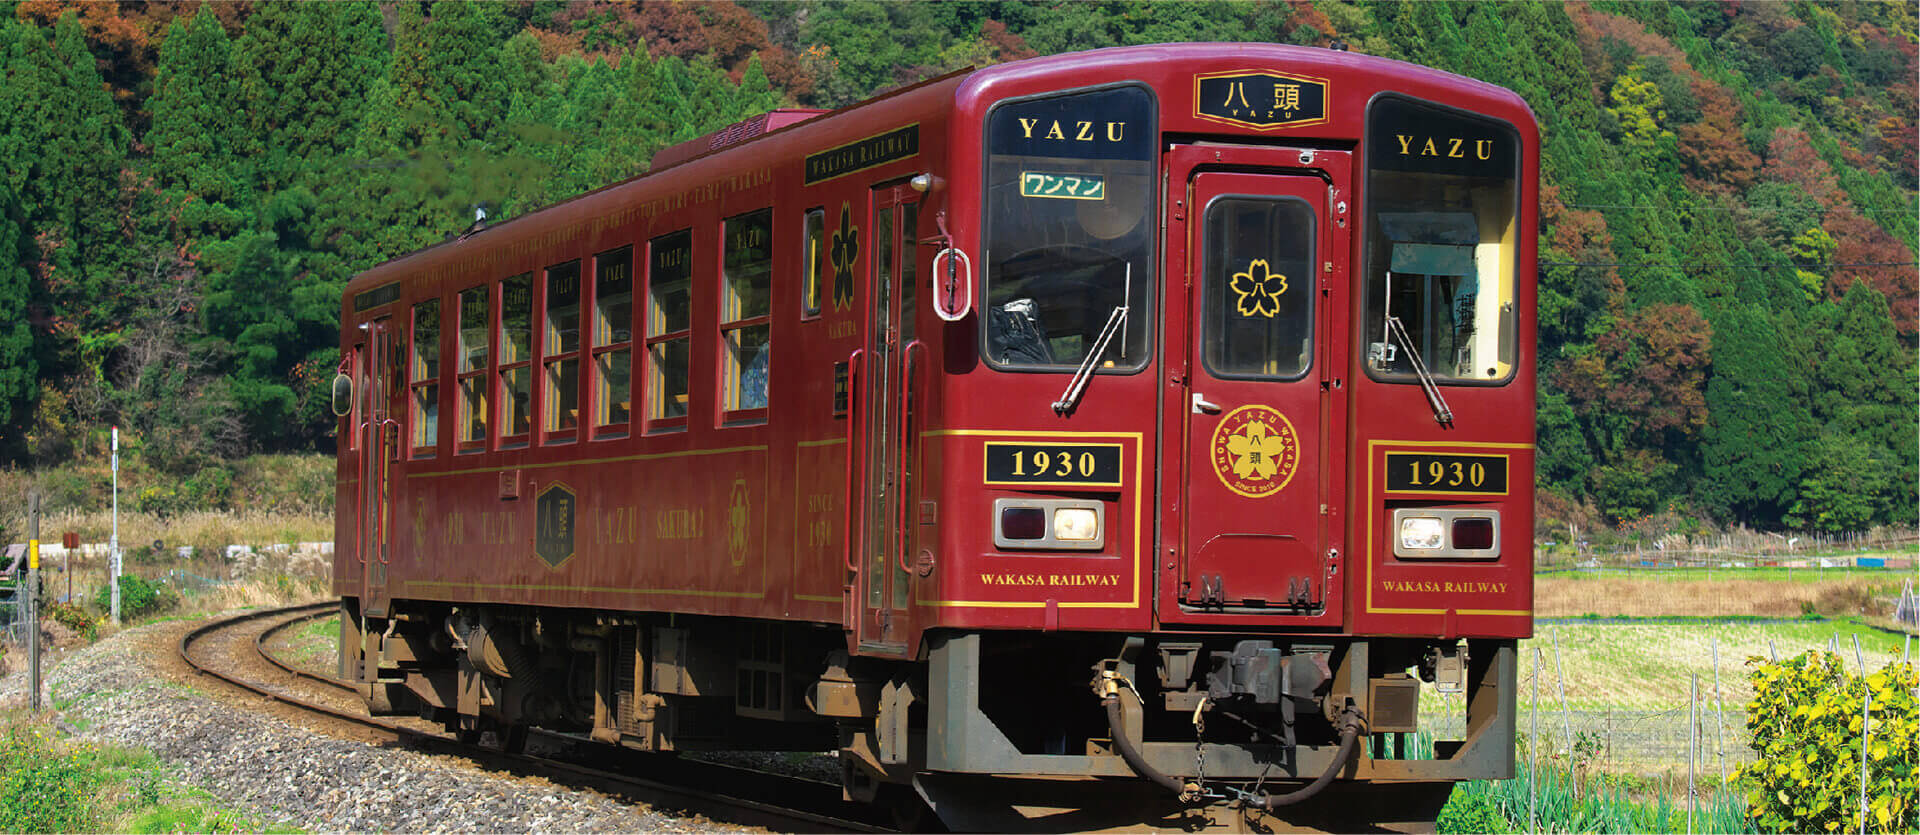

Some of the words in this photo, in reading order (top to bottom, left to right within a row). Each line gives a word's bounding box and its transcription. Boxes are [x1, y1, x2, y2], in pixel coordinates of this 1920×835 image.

[1223, 82, 1301, 110] 八頭
[1232, 109, 1292, 119] YAZU
[1017, 117, 1126, 142] YAZU
[1395, 134, 1493, 160] YAZU
[1025, 173, 1102, 196] ワンマン
[1233, 411, 1277, 424] YAZU
[1279, 426, 1294, 476] WAKASA
[1011, 450, 1096, 477] 1930
[1408, 460, 1486, 487] 1930
[593, 506, 638, 545] YAZU
[981, 573, 1045, 586] WAKASA
[1049, 574, 1121, 586] RAILWAY
[1383, 581, 1440, 593] WAKASA
[1444, 581, 1508, 593] RAILWAY
